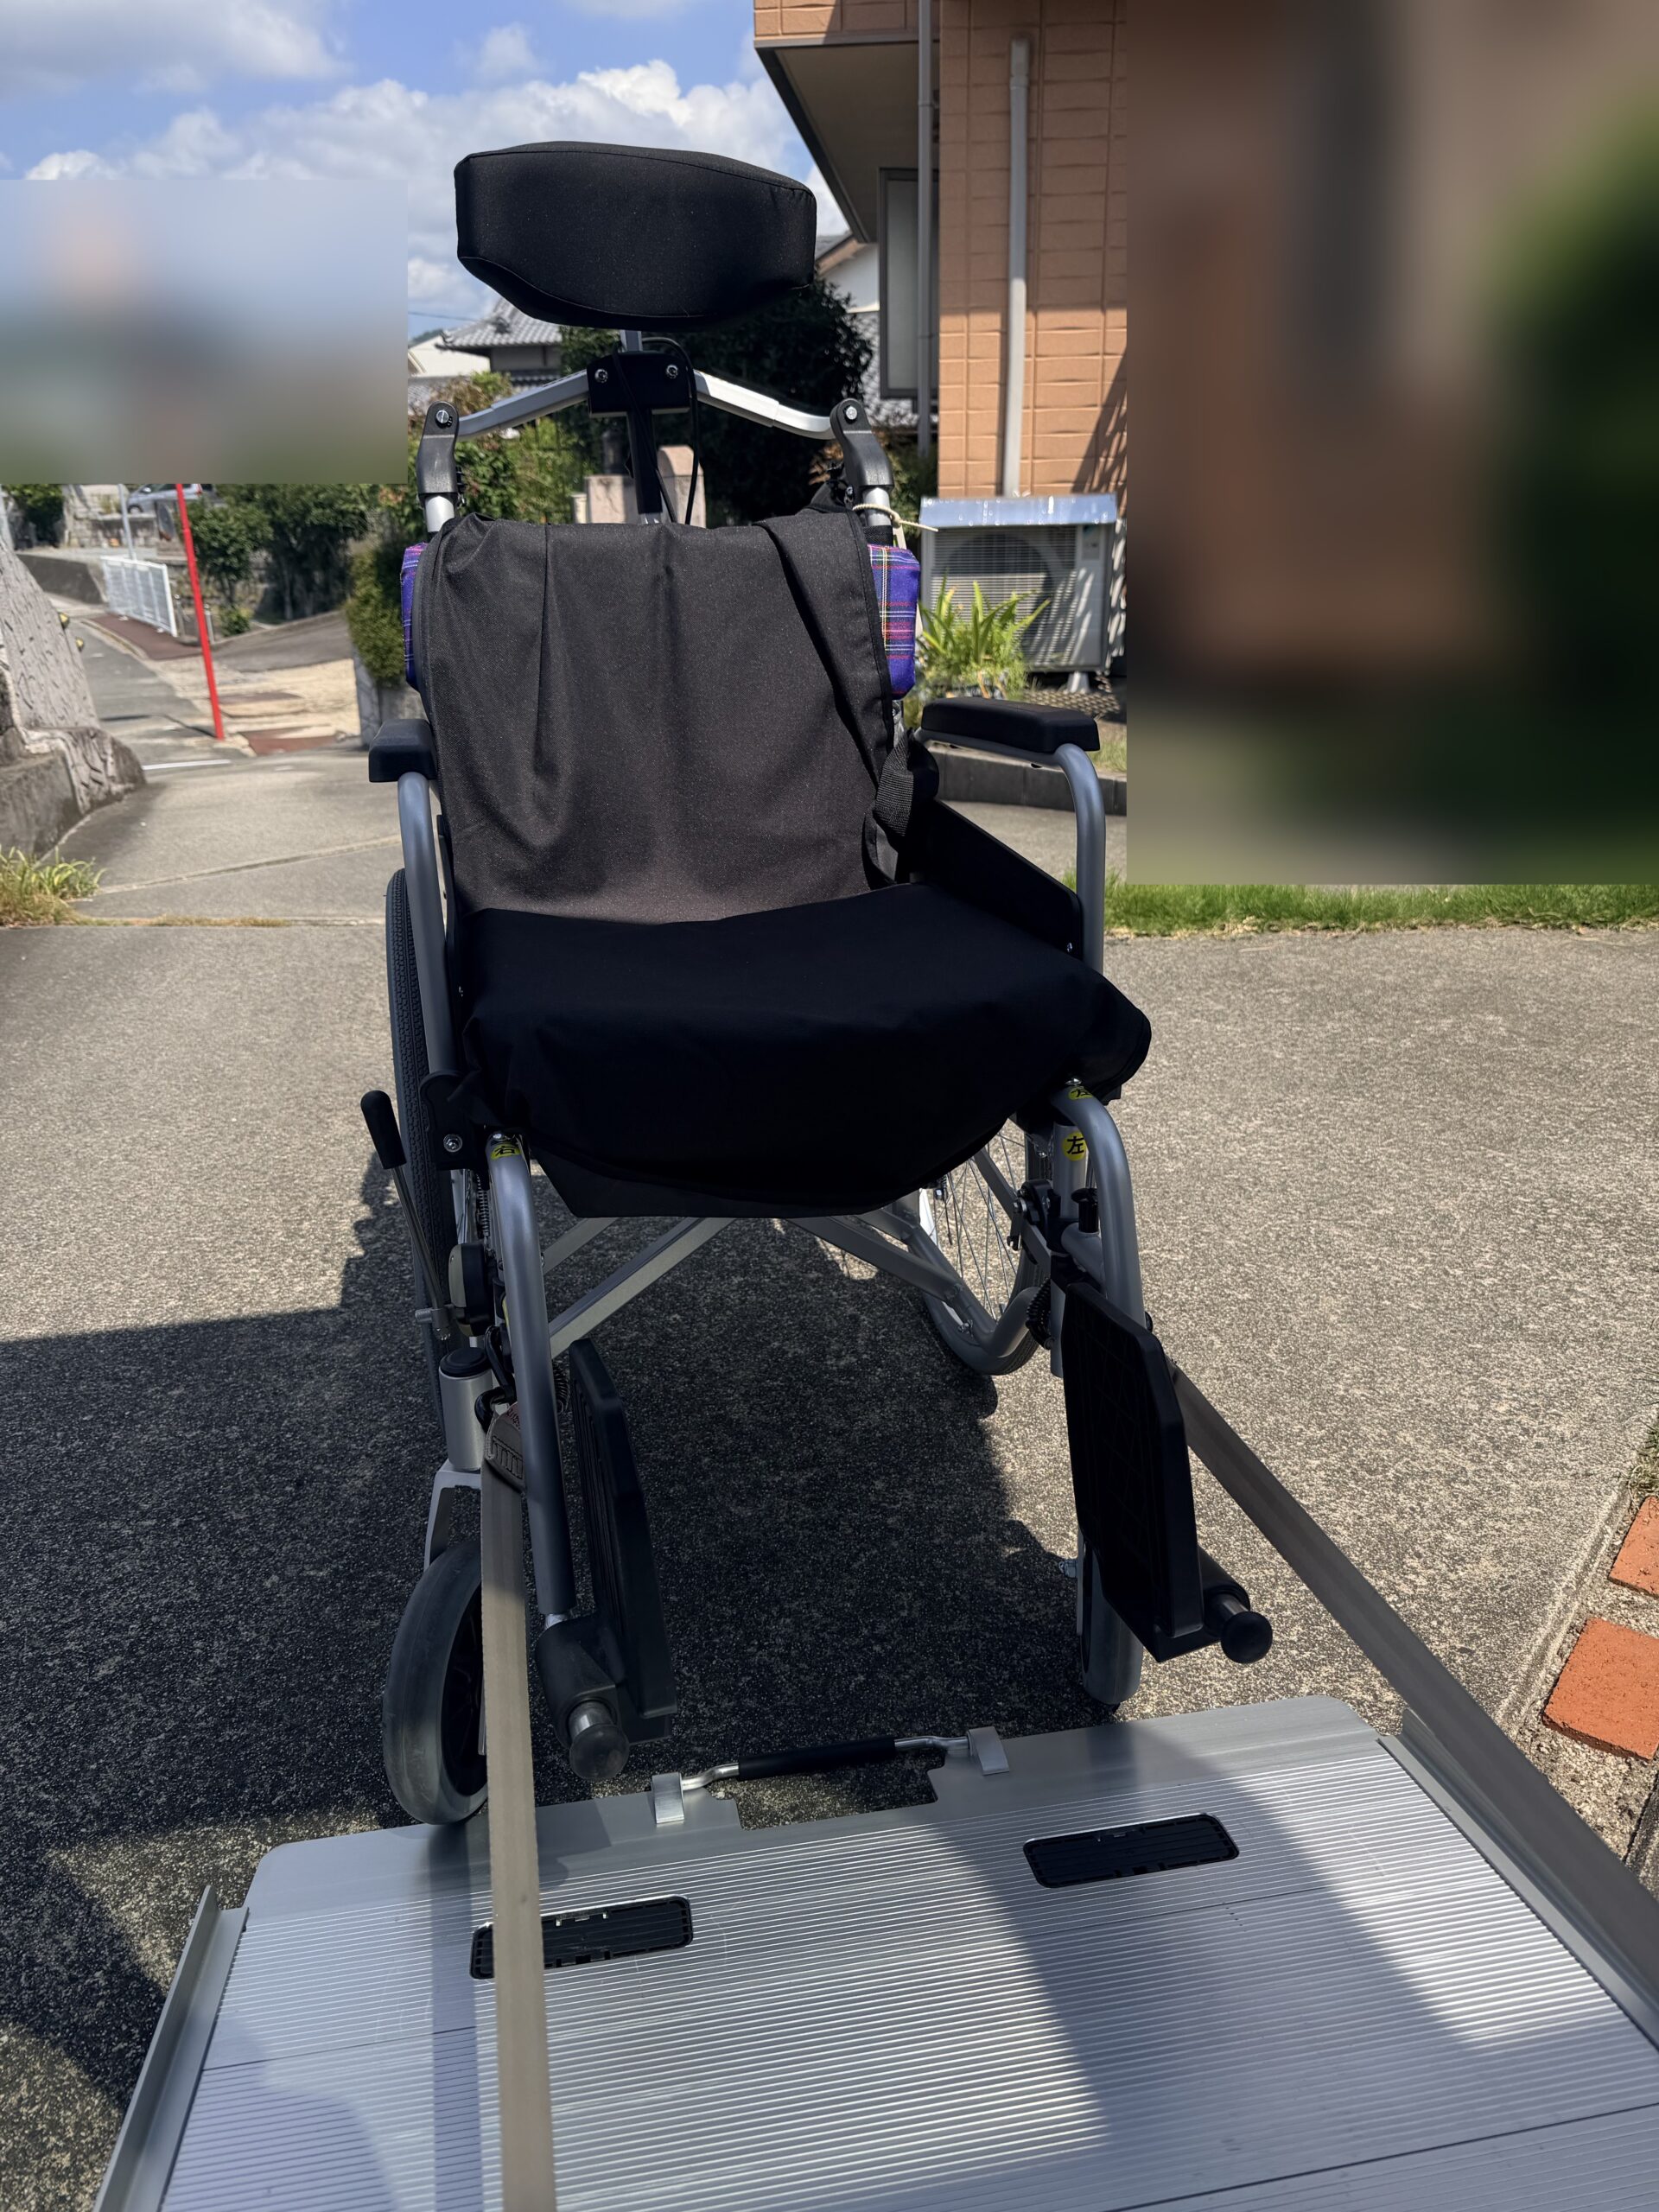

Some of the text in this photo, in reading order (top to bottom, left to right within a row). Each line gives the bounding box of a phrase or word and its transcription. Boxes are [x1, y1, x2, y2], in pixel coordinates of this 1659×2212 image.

[1071, 1089, 1091, 1097] 左
[1066, 1135, 1084, 1154] 左
[494, 1145, 517, 1156] 右
